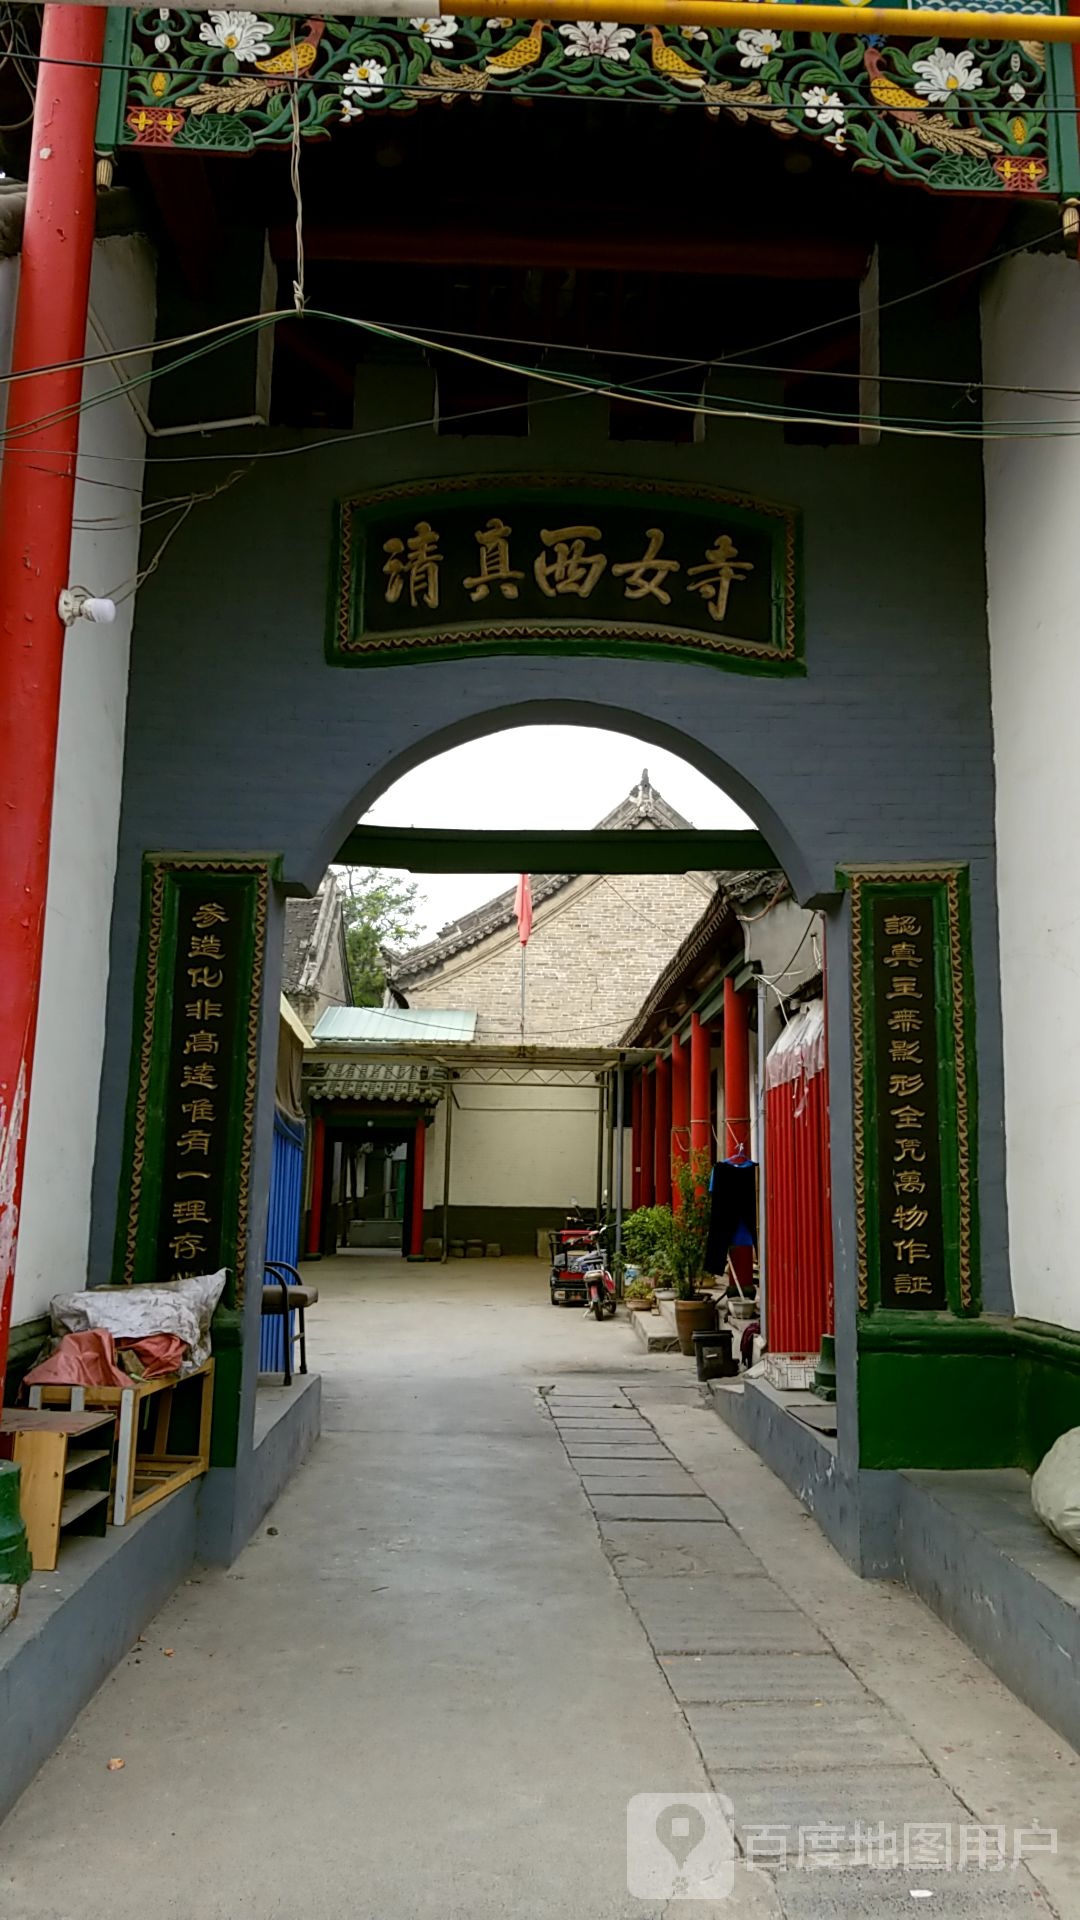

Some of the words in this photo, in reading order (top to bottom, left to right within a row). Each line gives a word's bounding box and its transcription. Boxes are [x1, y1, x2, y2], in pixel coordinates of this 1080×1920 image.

[382, 517, 754, 622] 清真西女寺
